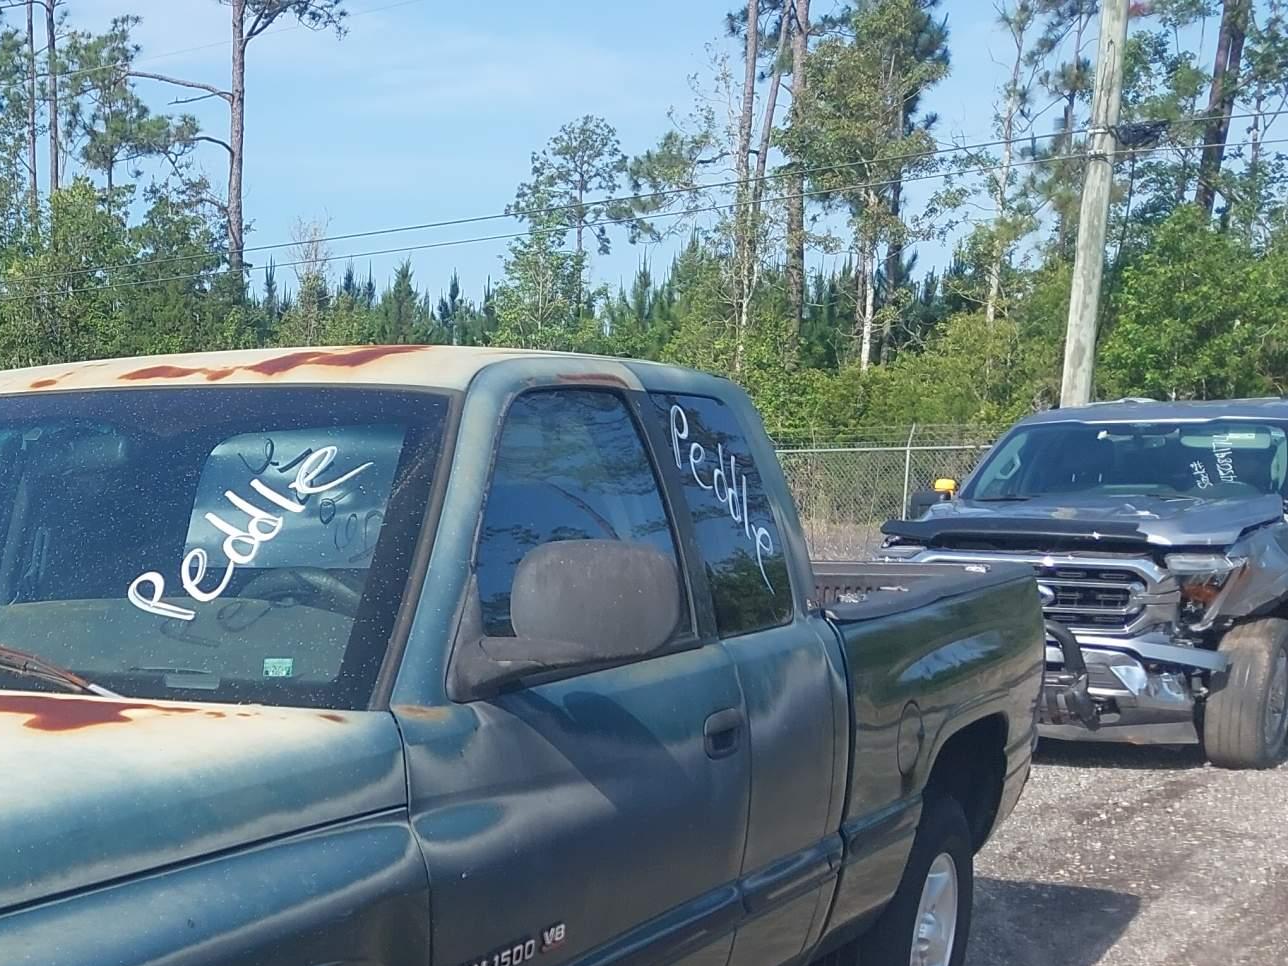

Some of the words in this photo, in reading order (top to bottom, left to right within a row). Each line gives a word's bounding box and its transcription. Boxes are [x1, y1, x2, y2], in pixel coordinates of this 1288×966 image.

[127, 445, 375, 621] Peddle
[670, 404, 776, 596] Peddle
[543, 924, 566, 946] V8
